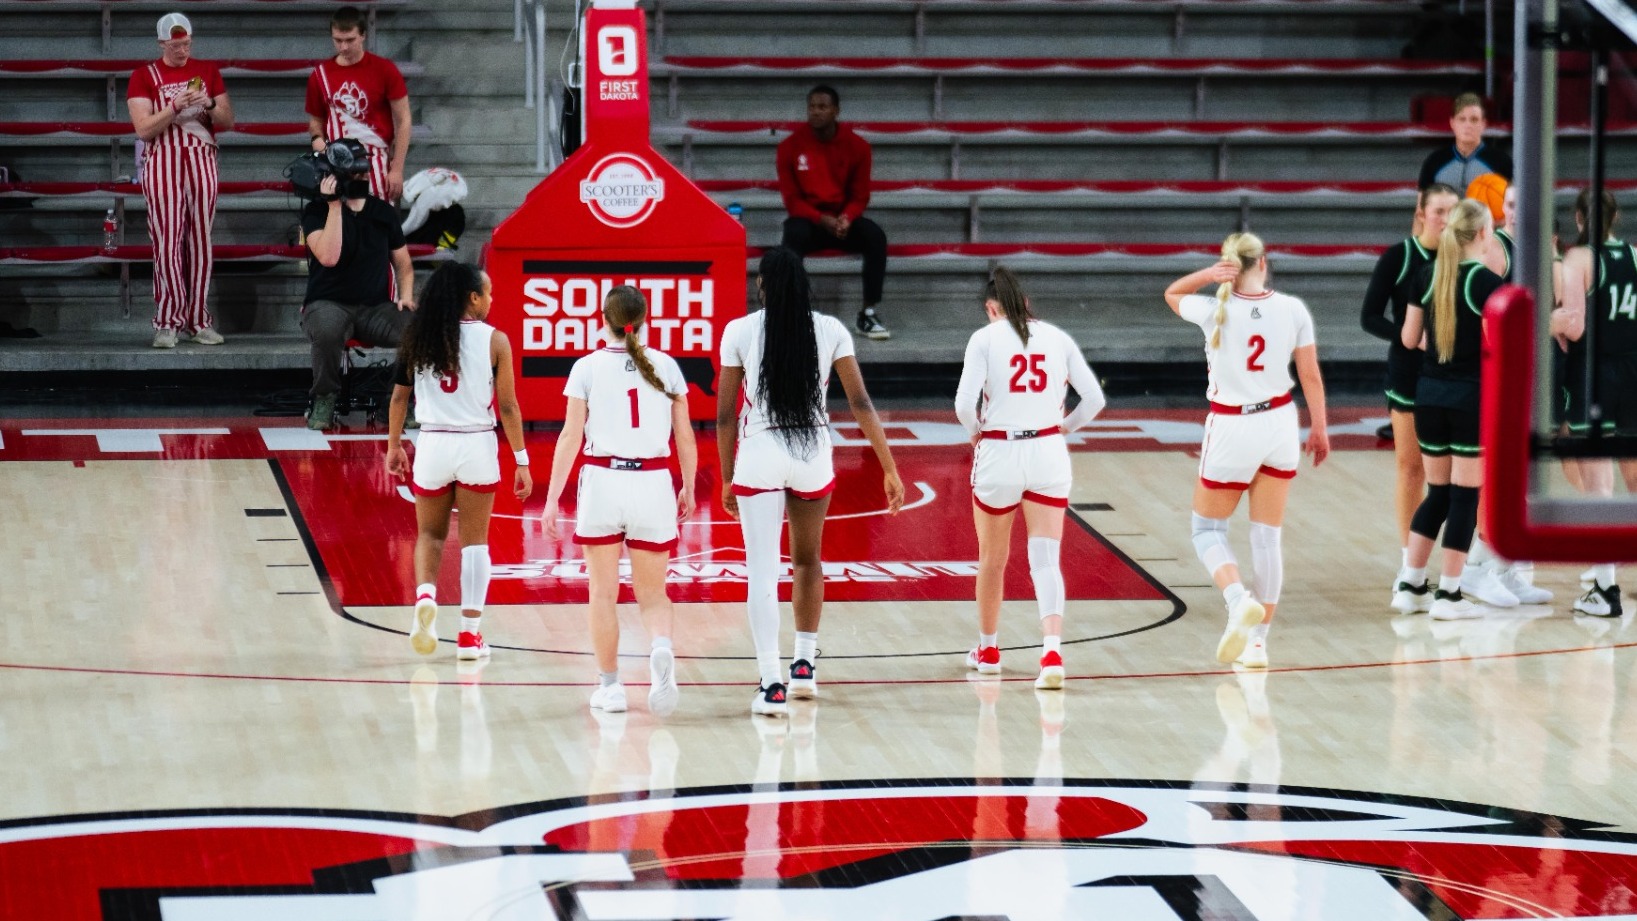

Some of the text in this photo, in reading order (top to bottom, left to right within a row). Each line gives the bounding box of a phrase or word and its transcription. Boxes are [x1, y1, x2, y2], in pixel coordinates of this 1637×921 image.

[600, 81, 638, 92] FIRST
[600, 92, 638, 100] DAKOTA
[585, 184, 658, 197] SCOOTER'S
[603, 198, 639, 207] COFFEE
[522, 278, 714, 317] SOTH
[1608, 283, 1637, 321] 14
[522, 318, 713, 351] DAKTA
[1246, 334, 1266, 372] 2
[1009, 354, 1048, 393] 25
[627, 388, 640, 429] 1
